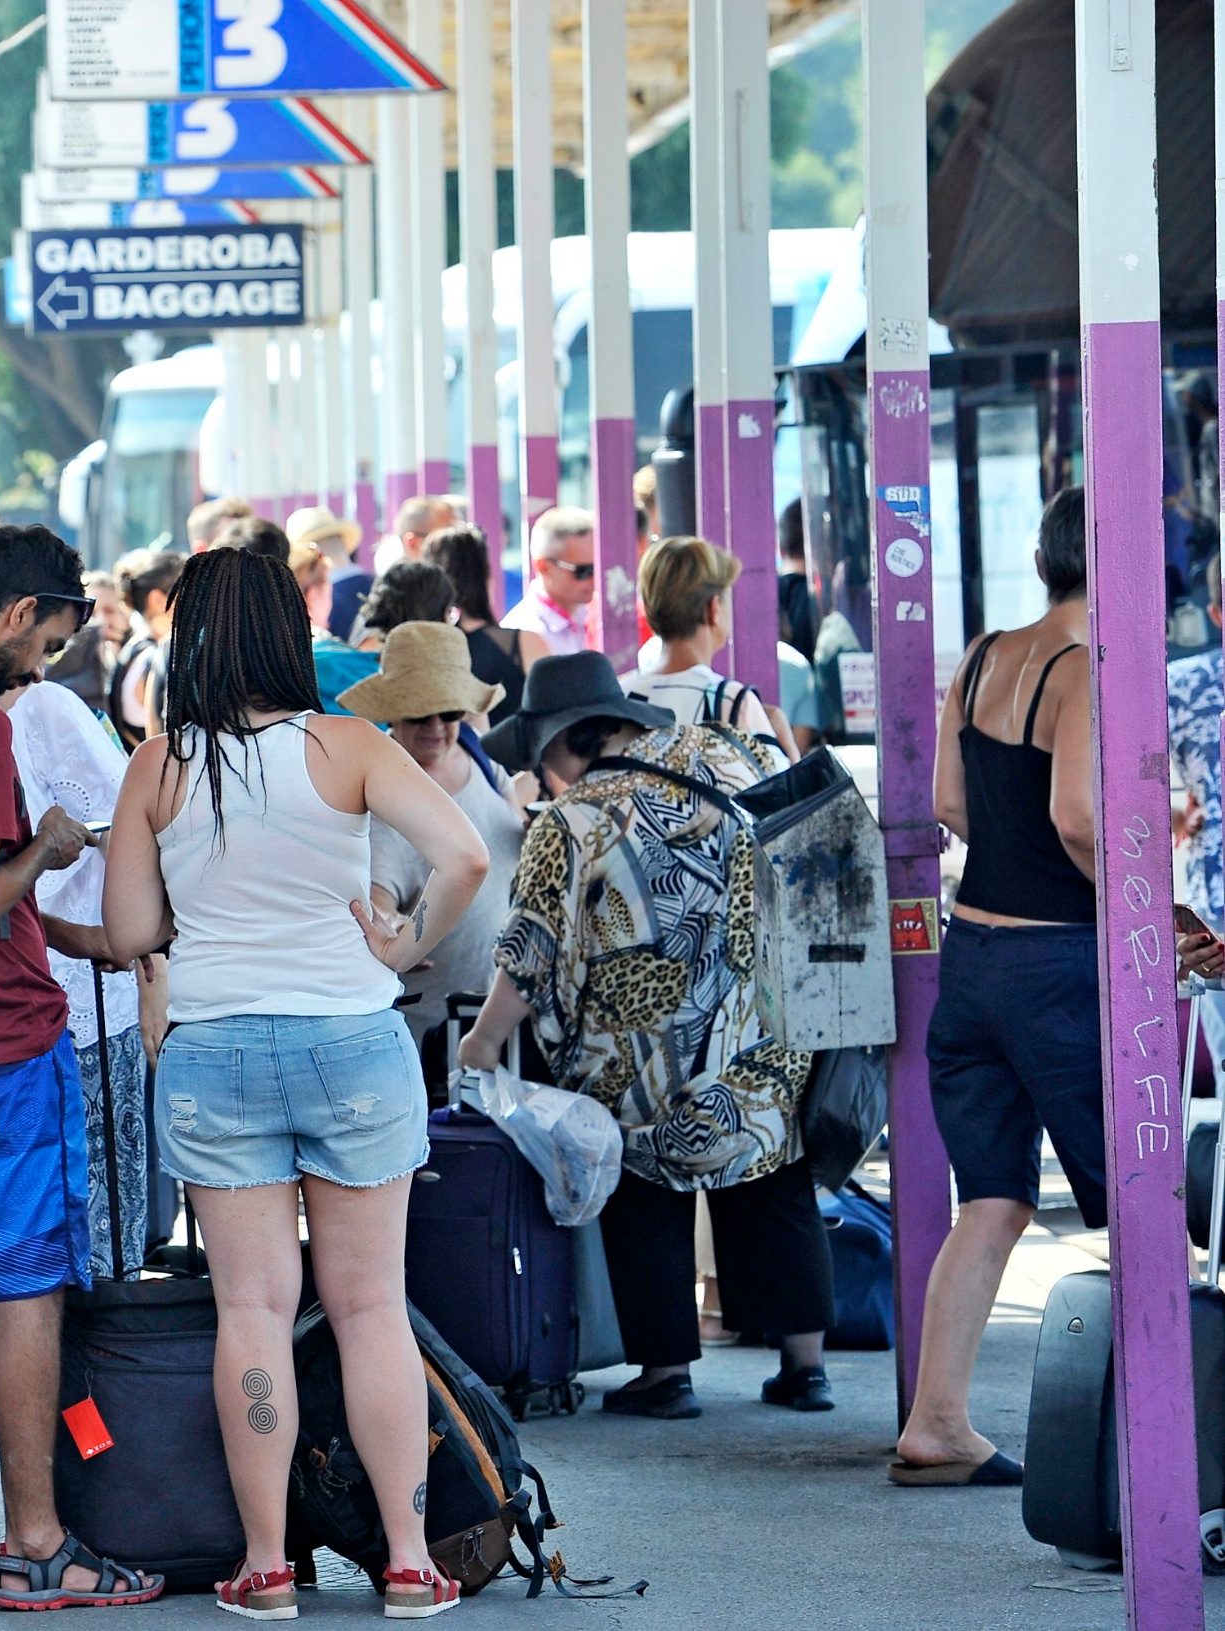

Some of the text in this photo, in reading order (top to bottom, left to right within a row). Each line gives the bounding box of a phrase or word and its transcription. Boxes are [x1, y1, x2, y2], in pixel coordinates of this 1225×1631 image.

[214, 0, 288, 88] 3
[35, 234, 300, 273] GARDEROBA
[92, 281, 300, 319] BAGGAGE
